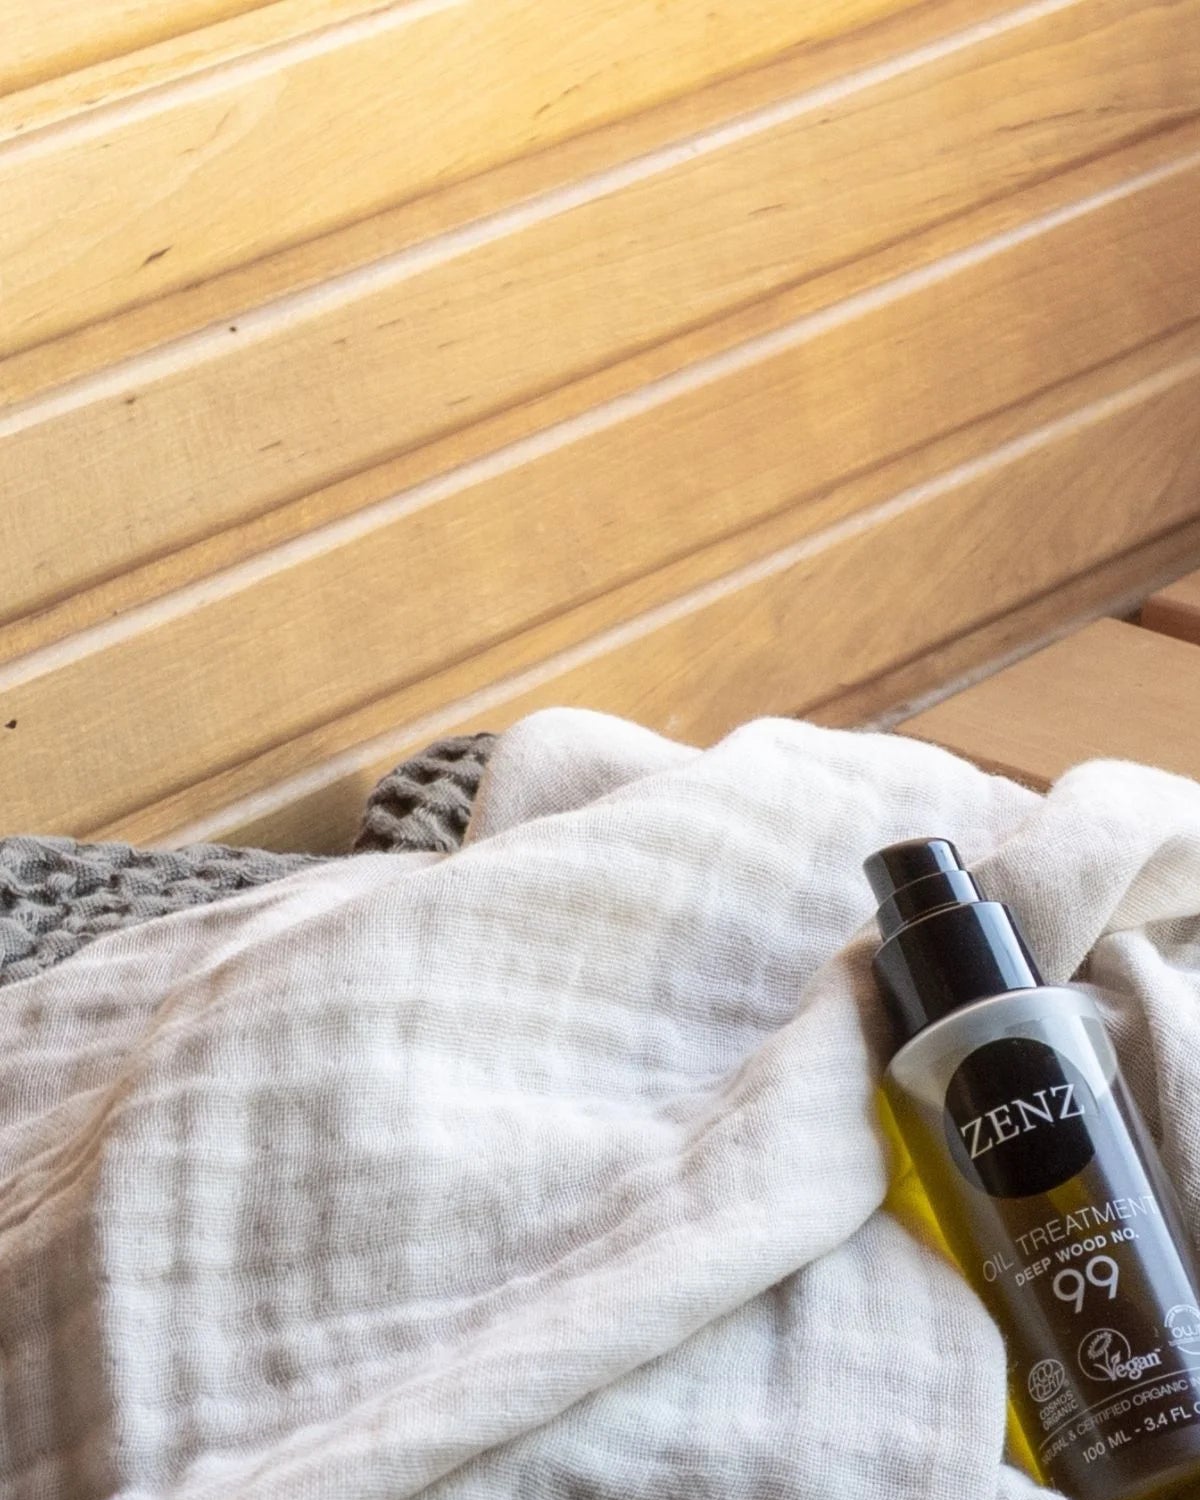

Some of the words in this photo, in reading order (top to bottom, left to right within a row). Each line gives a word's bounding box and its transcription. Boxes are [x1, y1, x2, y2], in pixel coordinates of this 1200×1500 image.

[961, 1083, 1085, 1160] ZENZ
[982, 1252, 1016, 1283] OIL
[1015, 1195, 1158, 1257] TREATMENT
[1014, 1257, 1052, 1288] DEEP
[1054, 1234, 1108, 1264] WOOD
[1110, 1226, 1140, 1245] NO.
[1052, 1254, 1120, 1315] 99
[1094, 1350, 1163, 1381] Vegan
[1039, 1389, 1075, 1421] COSMOS
[1042, 1399, 1079, 1431] ORGANIC
[1076, 1400, 1132, 1436] CERTIFIED
[1132, 1379, 1189, 1407] ORGANIC
[1082, 1441, 1106, 1464] 100
[1108, 1429, 1132, 1449] ML
[1144, 1413, 1169, 1432] 3.4
[1170, 1405, 1193, 1422] FL
